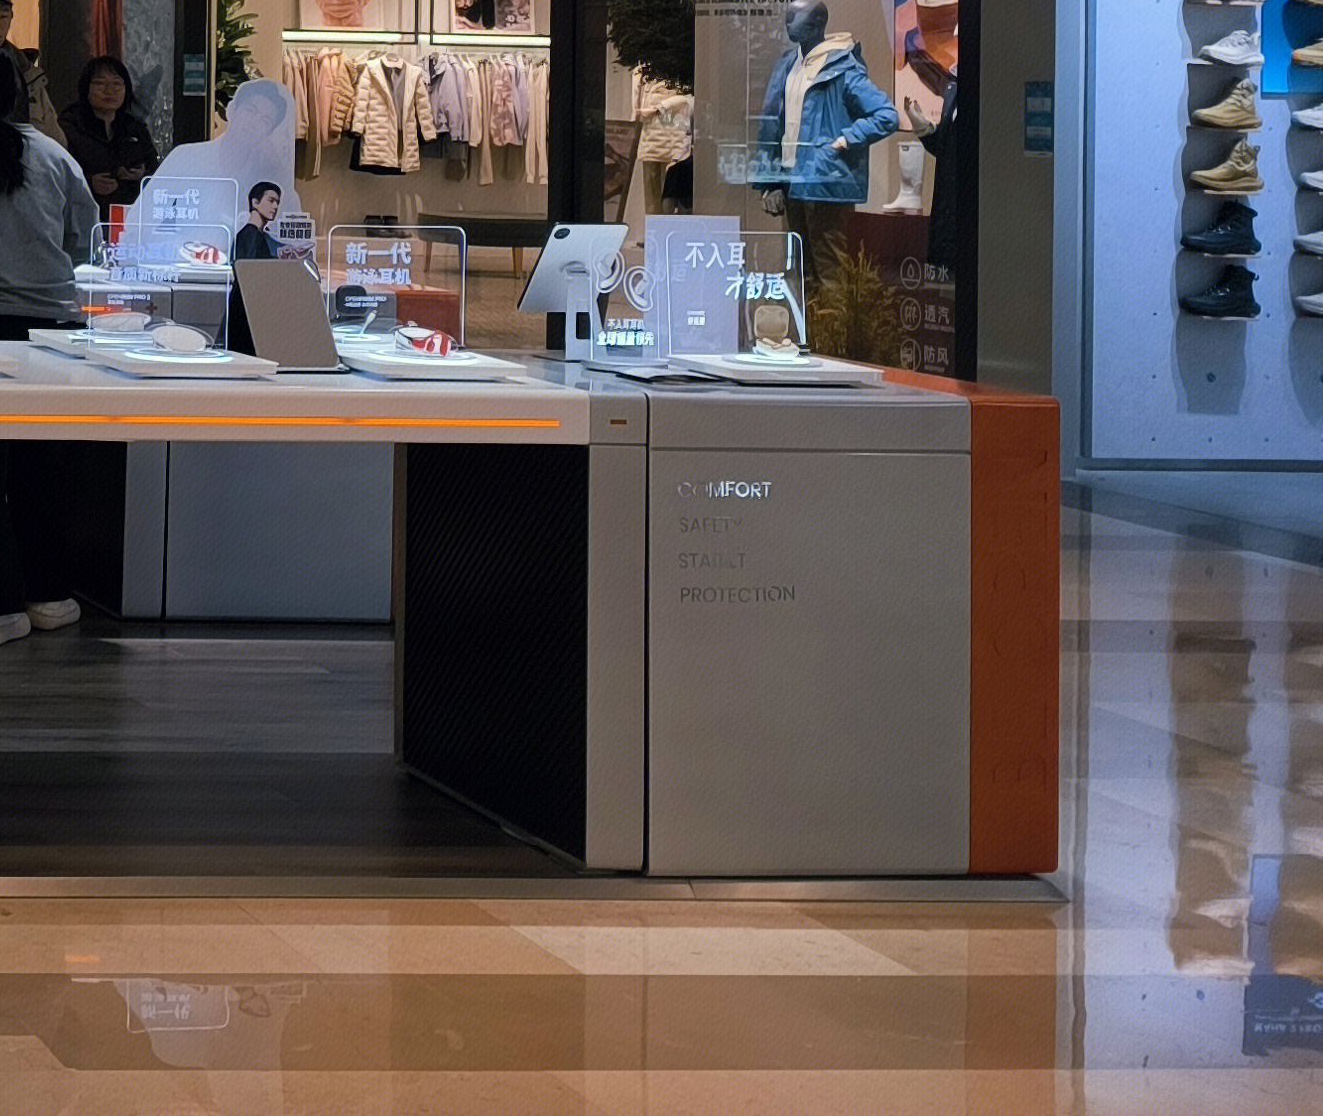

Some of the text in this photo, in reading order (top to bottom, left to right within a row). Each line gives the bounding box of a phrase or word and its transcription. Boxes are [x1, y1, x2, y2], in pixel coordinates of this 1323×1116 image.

[345, 242, 412, 265] 新一代
[685, 242, 746, 268] 不入耳
[345, 268, 412, 285] 游泳耳机
[923, 263, 950, 282] 防水
[725, 271, 785, 300] 才舒适
[923, 345, 949, 365] 防风
[680, 585, 795, 603] PROTECTION
